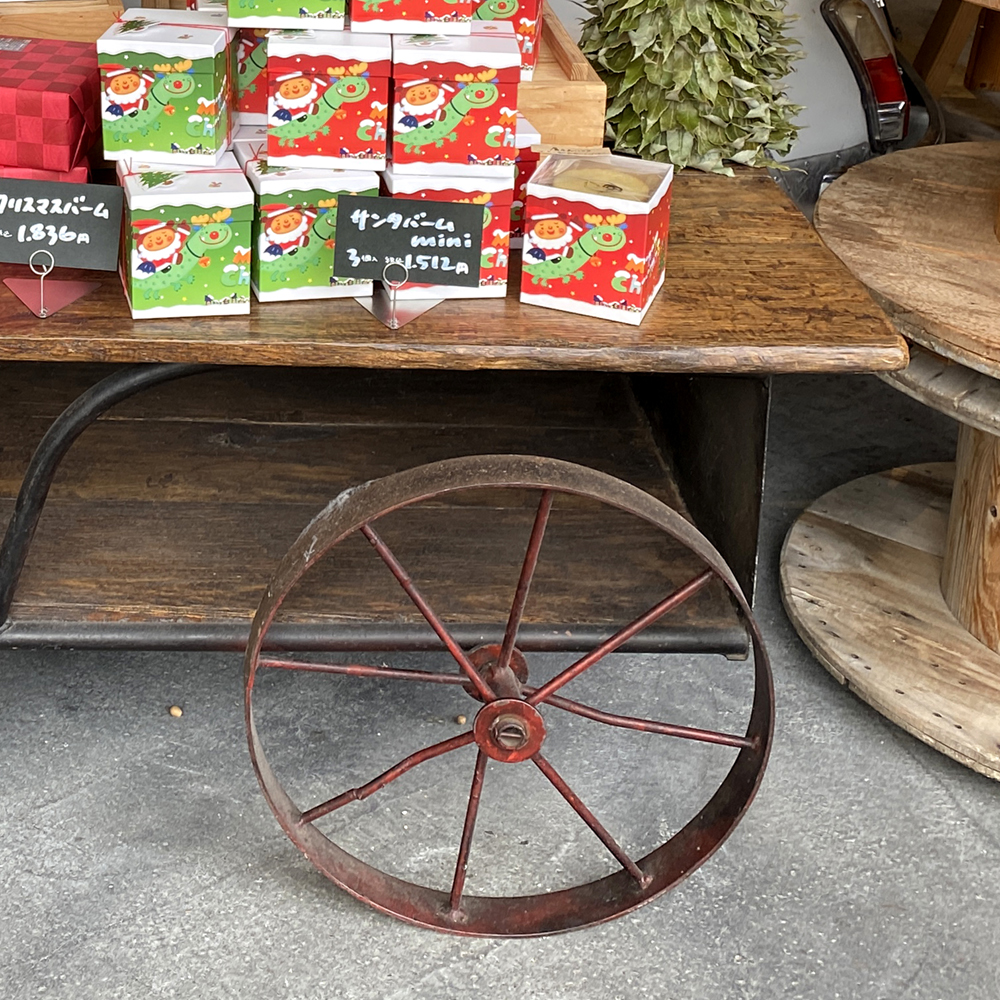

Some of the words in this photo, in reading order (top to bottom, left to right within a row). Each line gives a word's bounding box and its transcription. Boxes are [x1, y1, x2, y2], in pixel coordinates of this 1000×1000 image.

[350, 208, 455, 232] サンタバーム
[410, 233, 472, 248] mini
